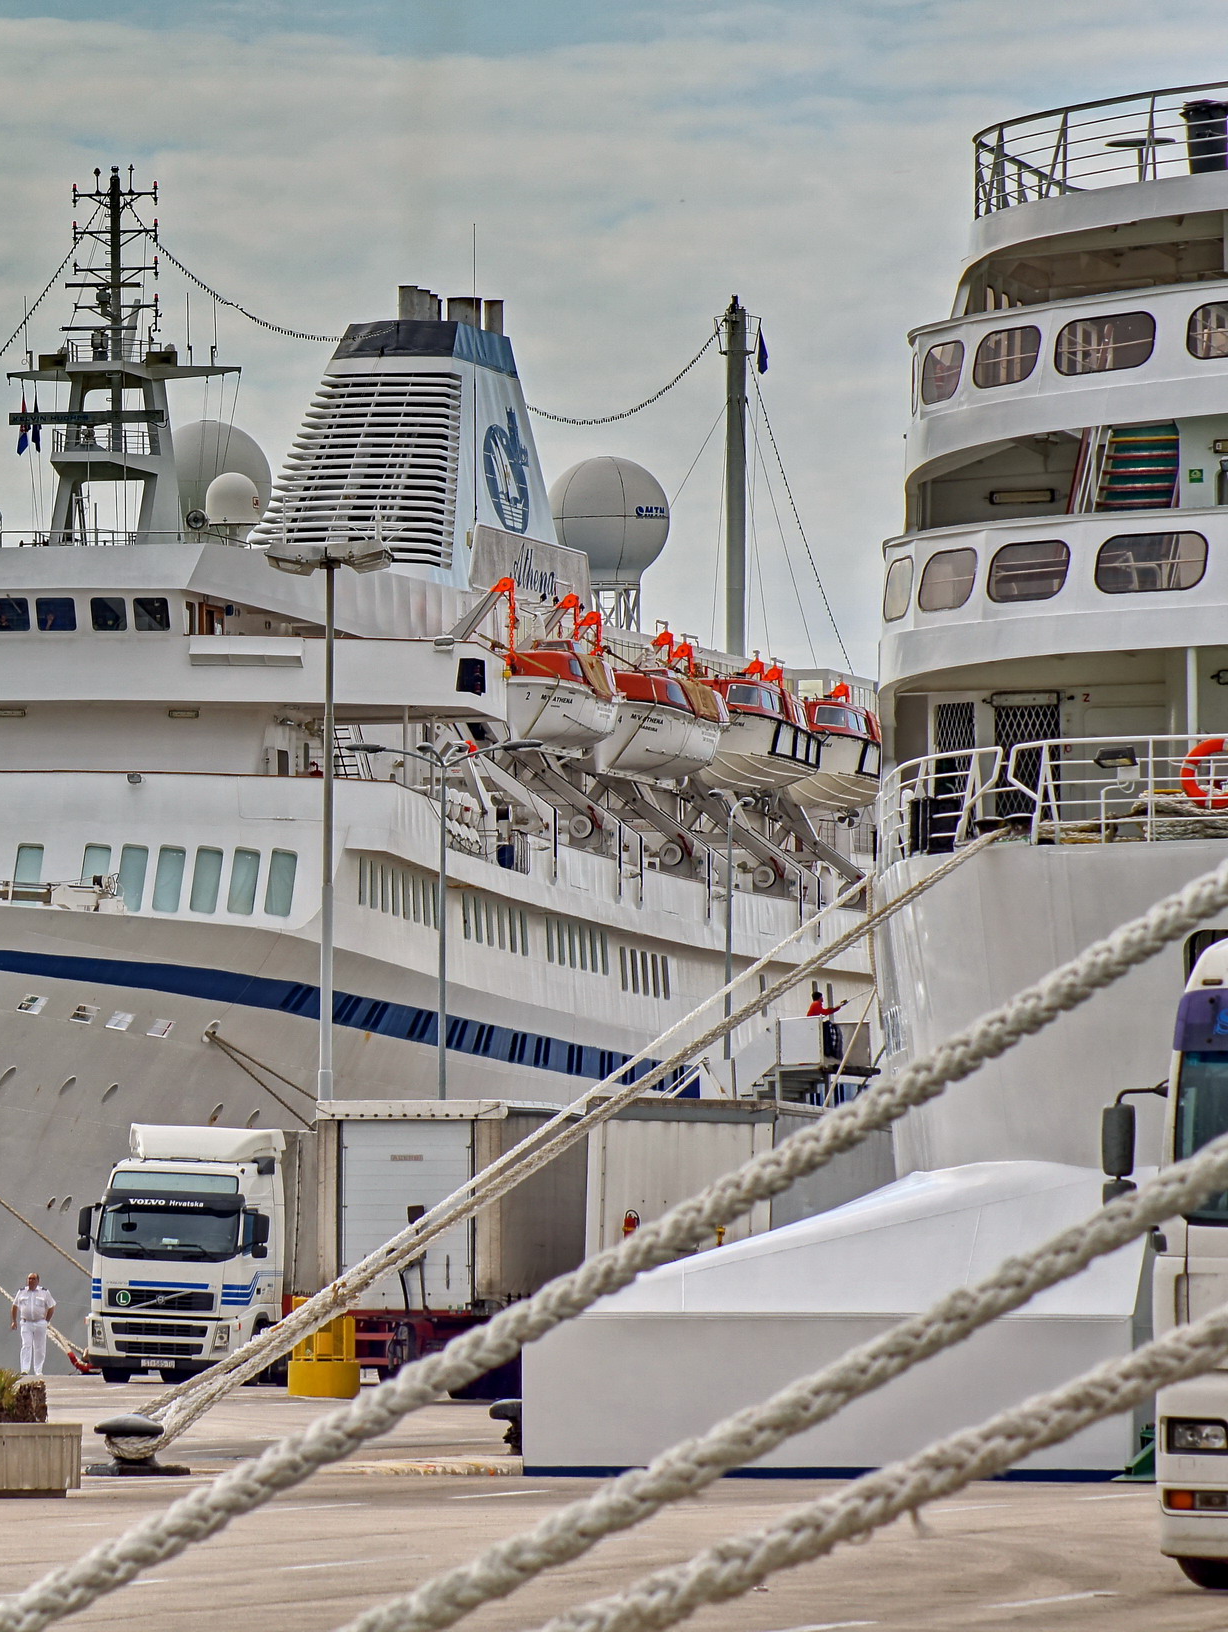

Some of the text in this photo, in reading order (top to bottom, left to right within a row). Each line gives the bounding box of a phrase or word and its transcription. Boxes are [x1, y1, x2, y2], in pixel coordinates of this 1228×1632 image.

[509, 543, 557, 597] Athena
[525, 692, 531, 701] 2
[552, 696, 573, 705] ATHENA
[618, 715, 623, 724] 4
[630, 713, 643, 721] M/V
[128, 1198, 204, 1208] VOLVO Hrvatska
[119, 1293, 127, 1304] L
